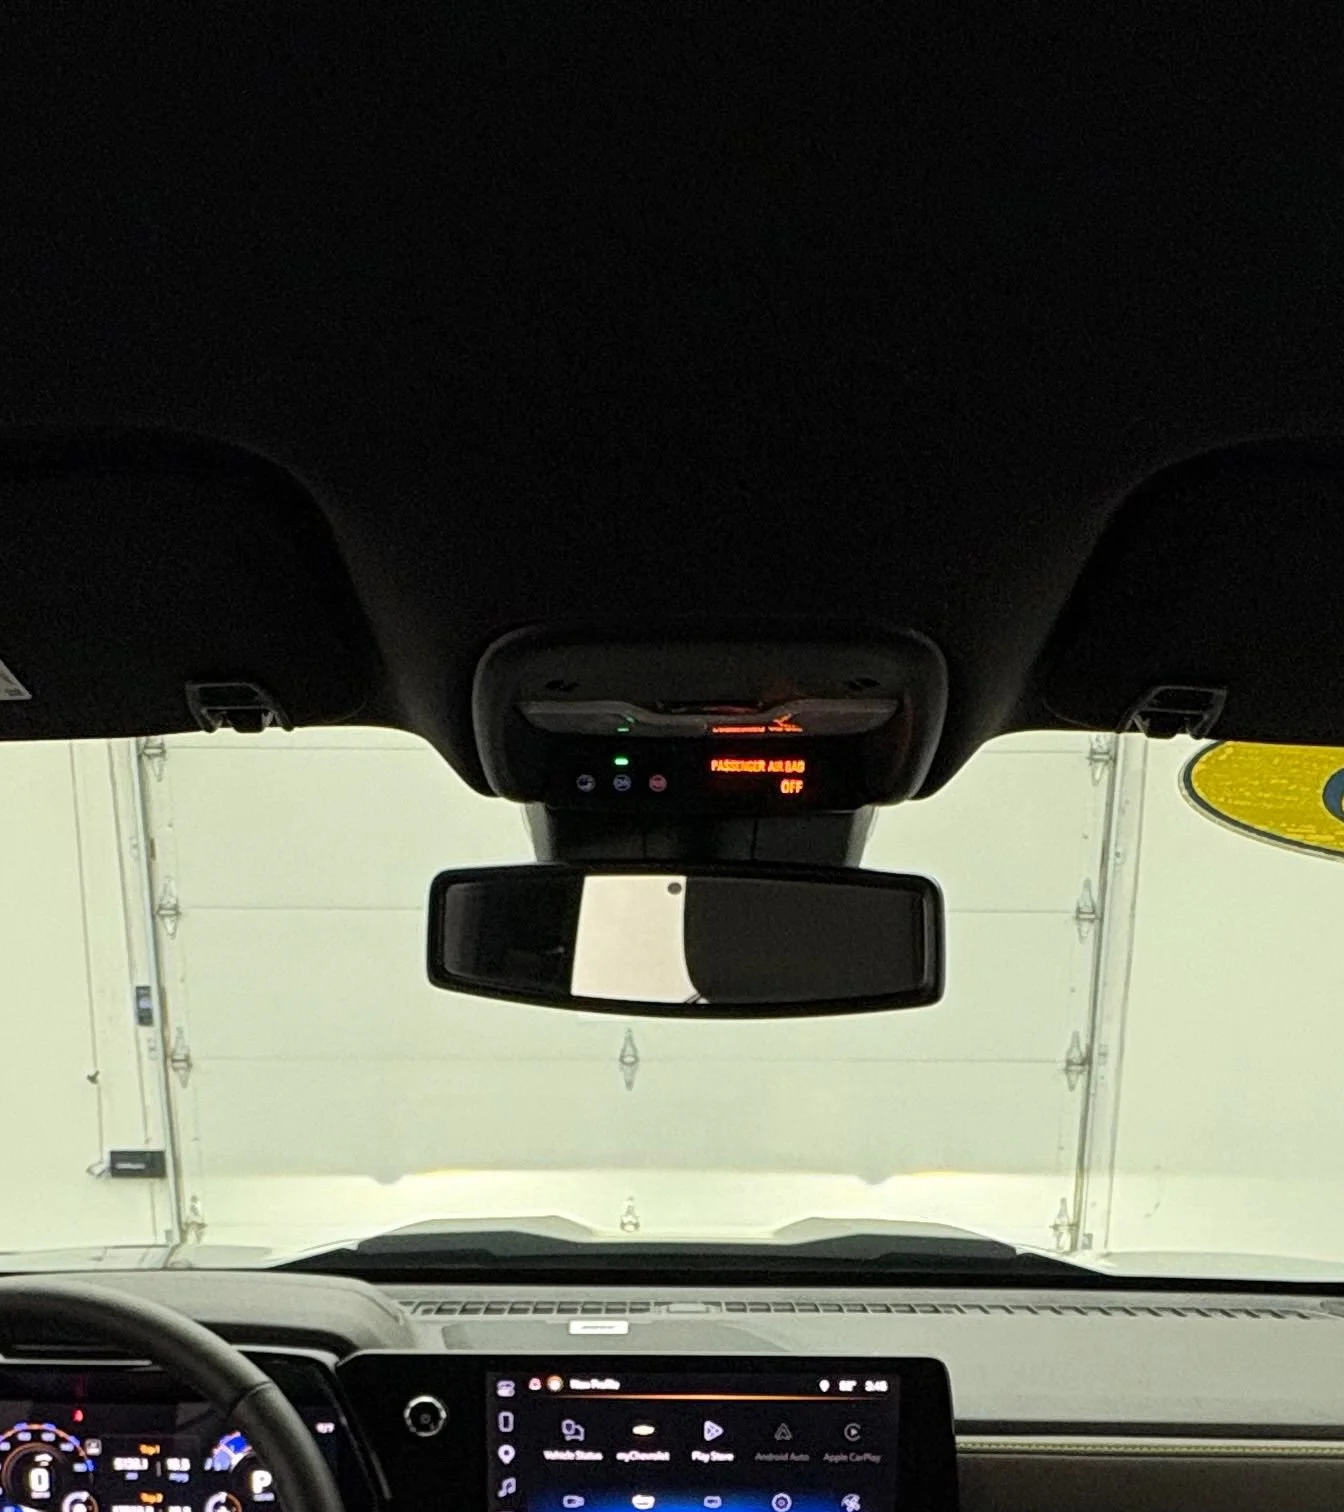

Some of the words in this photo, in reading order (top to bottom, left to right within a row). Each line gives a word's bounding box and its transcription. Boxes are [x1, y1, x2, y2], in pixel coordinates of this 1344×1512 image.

[711, 760, 766, 772] PASSENGER
[768, 760, 785, 773] AIR
[785, 760, 806, 773] BAG
[780, 779, 804, 794] OFF
[692, 1450, 710, 1464] Play
[710, 1450, 734, 1462] Store
[755, 1452, 788, 1462] Android
[789, 1452, 810, 1462] Auto
[823, 1452, 848, 1464] Apple
[849, 1452, 881, 1464] CarPlay
[251, 1469, 272, 1494] P
